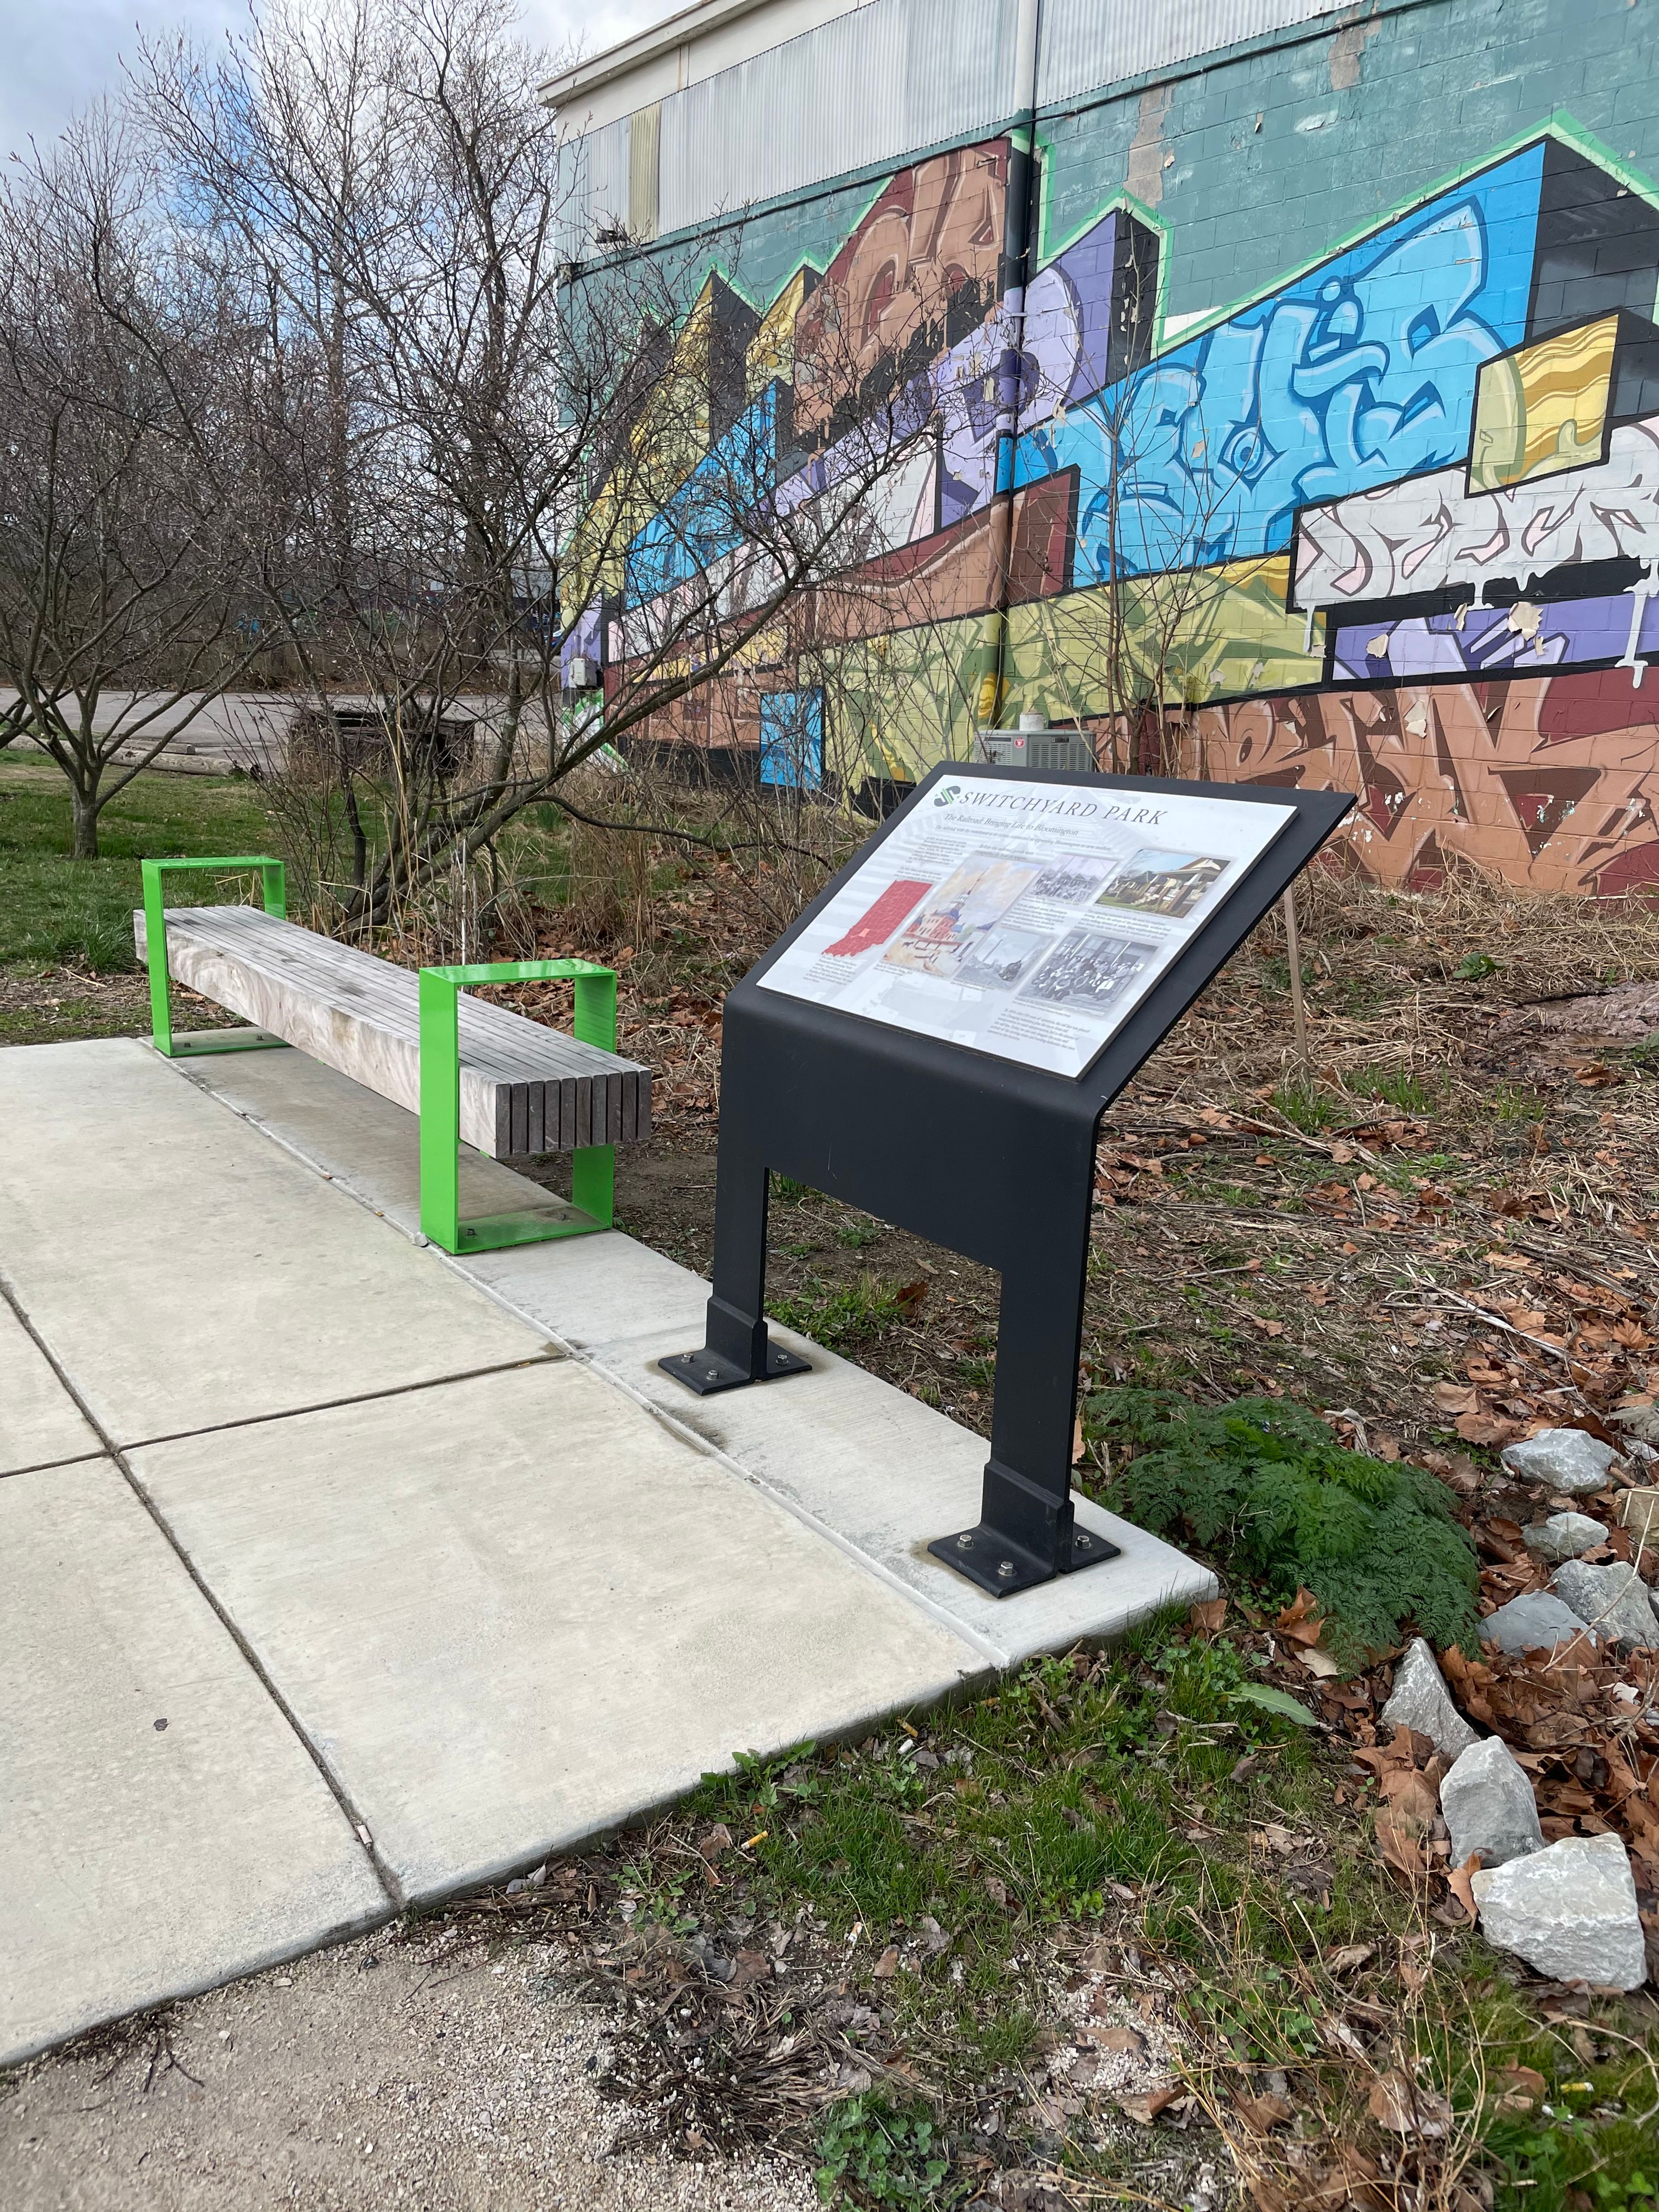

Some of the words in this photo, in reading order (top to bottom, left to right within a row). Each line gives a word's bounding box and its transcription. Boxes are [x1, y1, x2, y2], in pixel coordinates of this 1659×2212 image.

[959, 792, 1097, 817] SWITCHYARD
[1102, 806, 1168, 824] PARK
[957, 815, 984, 823] Railroad:
[984, 818, 1011, 829] Bringing
[1034, 824, 1078, 836] Bloomington
